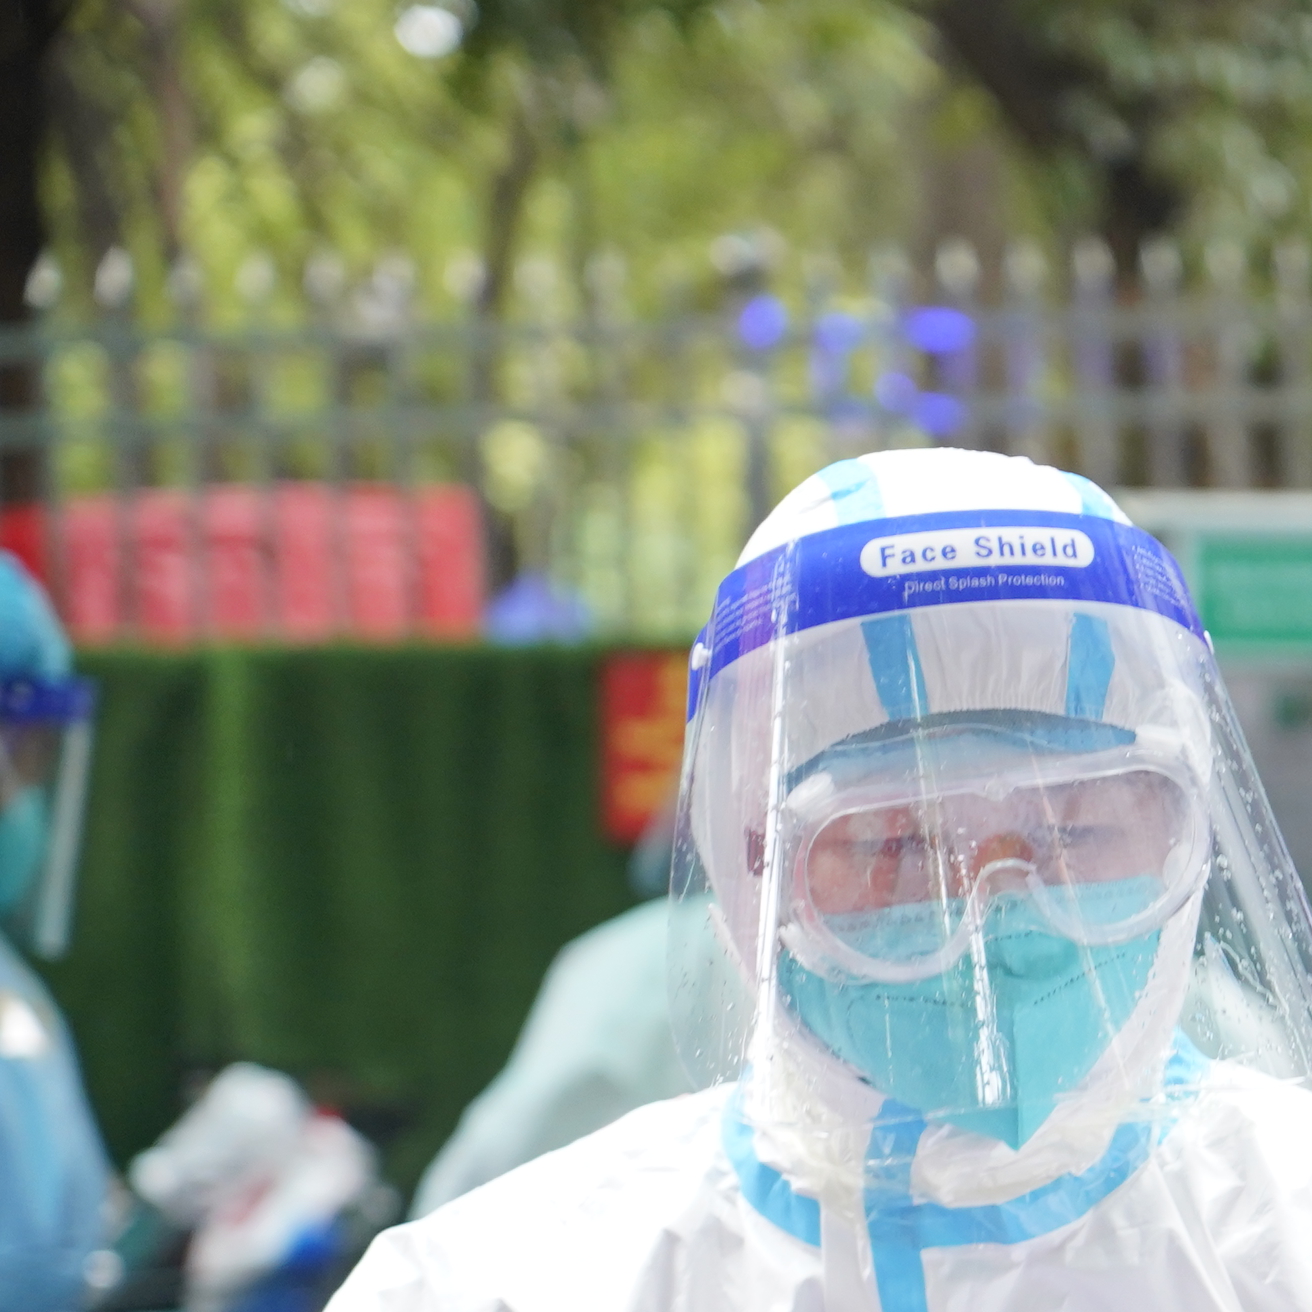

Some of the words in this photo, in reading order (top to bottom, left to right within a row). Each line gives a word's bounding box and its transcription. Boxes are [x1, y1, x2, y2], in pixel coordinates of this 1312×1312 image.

[880, 544, 957, 568] Face
[974, 536, 1078, 560] Shield
[905, 577, 945, 595] Direct
[949, 575, 995, 592] Splash
[998, 573, 1065, 587] Protection
